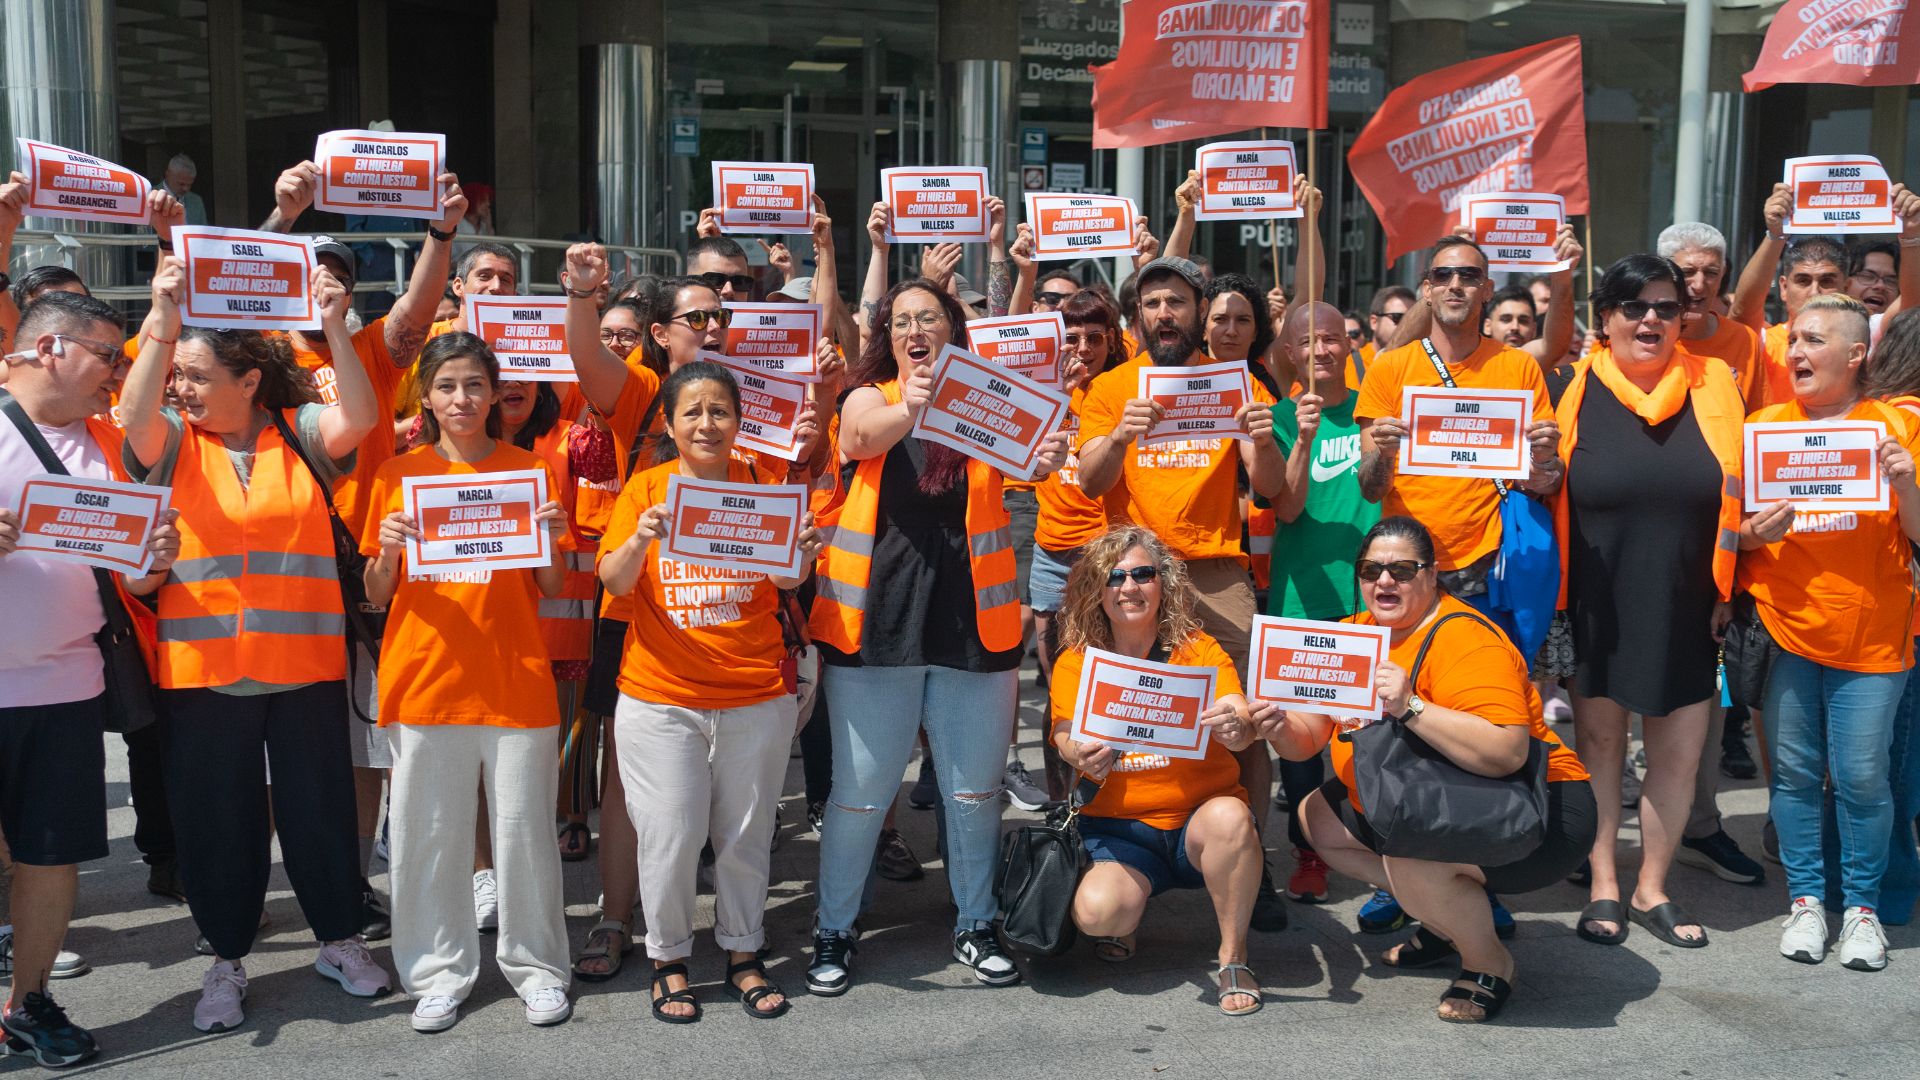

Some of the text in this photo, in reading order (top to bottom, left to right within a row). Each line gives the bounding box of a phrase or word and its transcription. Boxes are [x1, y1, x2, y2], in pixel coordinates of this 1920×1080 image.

[1086, 15, 1119, 32] Juz
[1033, 38, 1119, 60] Juzgados
[1327, 77, 1370, 94] adrid
[352, 144, 408, 155] JUAN CARLOS
[1236, 153, 1258, 163] MARÍA
[64, 165, 111, 179] EN HUELGA
[355, 160, 403, 172] EN HUELGA
[1828, 168, 1860, 177] MARCOS
[344, 173, 417, 187] CONTRA NESTAR
[753, 173, 774, 181] LAURA
[1226, 168, 1267, 179] EN HUELGA
[53, 176, 125, 193] CONTRA NESTAR
[922, 178, 950, 188] SANDRA
[1217, 180, 1278, 192] CONTRA NESTAR
[1819, 182, 1864, 192] EN HUELGA
[358, 189, 401, 202] MÓSTOLES
[746, 185, 783, 196] EN HUELGA
[916, 192, 956, 202] EN HUELGA
[59, 194, 117, 208] CARABANCHEL
[737, 197, 793, 207] CONTRA NESTAR
[1232, 197, 1265, 206] VALLECAS
[1808, 194, 1876, 206] CONTRA NESTAR
[907, 204, 967, 214] CONTRA NESTAR
[1061, 208, 1102, 219] EN HUELGA
[1506, 204, 1529, 214] RUBÉN
[1824, 211, 1860, 220] VALLECAS
[749, 212, 781, 222] VALLECAS
[921, 220, 954, 230] VALLECAS
[1053, 219, 1114, 231] CONTRA NESTAR
[1495, 220, 1536, 230] EN HUELGA
[1240, 220, 1294, 247] PÚB
[1485, 232, 1547, 244] CONTRA NESTAR
[1067, 236, 1101, 247] VALLECAS
[232, 244, 264, 257] ISABEL
[1498, 249, 1531, 258] VALLECAS
[221, 261, 273, 276] EN HUELGA
[209, 276, 288, 293] CONTRA NESTAR
[227, 300, 270, 312] VALLECAS
[513, 310, 541, 320] MIRIAM
[760, 316, 777, 325] DANI
[505, 326, 549, 337] EN HUELGA
[746, 330, 788, 341] EN HUELGA
[999, 327, 1030, 338] PATRICIA
[496, 338, 562, 351] CONTRA NESTAR
[736, 343, 798, 353] CONTRA NESTAR
[998, 340, 1036, 353] EN HUELGA
[510, 356, 550, 367] VICÁLVARO
[992, 353, 1046, 366] CONTRA NESTAR
[1431, 354, 1448, 379] umbro
[744, 375, 766, 390] TANIA
[988, 379, 1011, 397] SARA
[1187, 379, 1211, 390] RODRI
[979, 395, 1016, 417] HUELGA
[1176, 393, 1220, 406] EN HUELGA
[748, 405, 782, 423] NESTAR
[1164, 406, 1232, 418] CONTRA NESTAR
[1455, 403, 1479, 413] DAVID
[947, 399, 1022, 438] CONTRA NESTAR
[1440, 418, 1489, 431] EN HUELGA
[1177, 421, 1215, 430] VALLECAS
[955, 422, 996, 447] VALLECAS
[1428, 431, 1502, 445] CONTRA NESTAR
[1805, 436, 1826, 446] MATI
[1320, 433, 1361, 463] NIKE
[1138, 453, 1210, 468] DE MADRID
[1451, 451, 1477, 462] PARLA
[1788, 451, 1841, 465] EN HUELGA
[1776, 465, 1857, 479] CONTRA NESTAR
[458, 489, 493, 502] MARCIA
[1790, 485, 1842, 495] VILLAVERDE
[75, 491, 110, 507] ÓSCAR
[722, 496, 755, 509] HELENA
[56, 508, 117, 527] EN HUELGA
[449, 505, 501, 520] EN HUELGA
[708, 511, 762, 527] EN HUELGA
[1792, 511, 1858, 532] MADRID
[40, 522, 129, 541] CONTRA NESTAR
[438, 520, 518, 537] CONTRA NESTAR
[693, 522, 774, 541] CONTRA NESTAR
[55, 539, 104, 553] VALLECAS
[455, 541, 503, 556] MÓSTOLES
[709, 543, 754, 556] VALLECAS
[663, 560, 682, 580] DE
[664, 585, 755, 607] E INQUILINOS
[688, 602, 741, 628] MADRID
[1304, 635, 1336, 649] HELENA
[1291, 651, 1343, 668] EN HUELGA
[1278, 664, 1356, 683] CONTRA NESTAR
[1138, 676, 1162, 689] BEGO
[1294, 685, 1336, 699] VALLECAS
[1119, 690, 1173, 709] EN HUELGA
[1105, 702, 1184, 725] CONTRA NESTAR
[1127, 726, 1154, 739] PARLA
